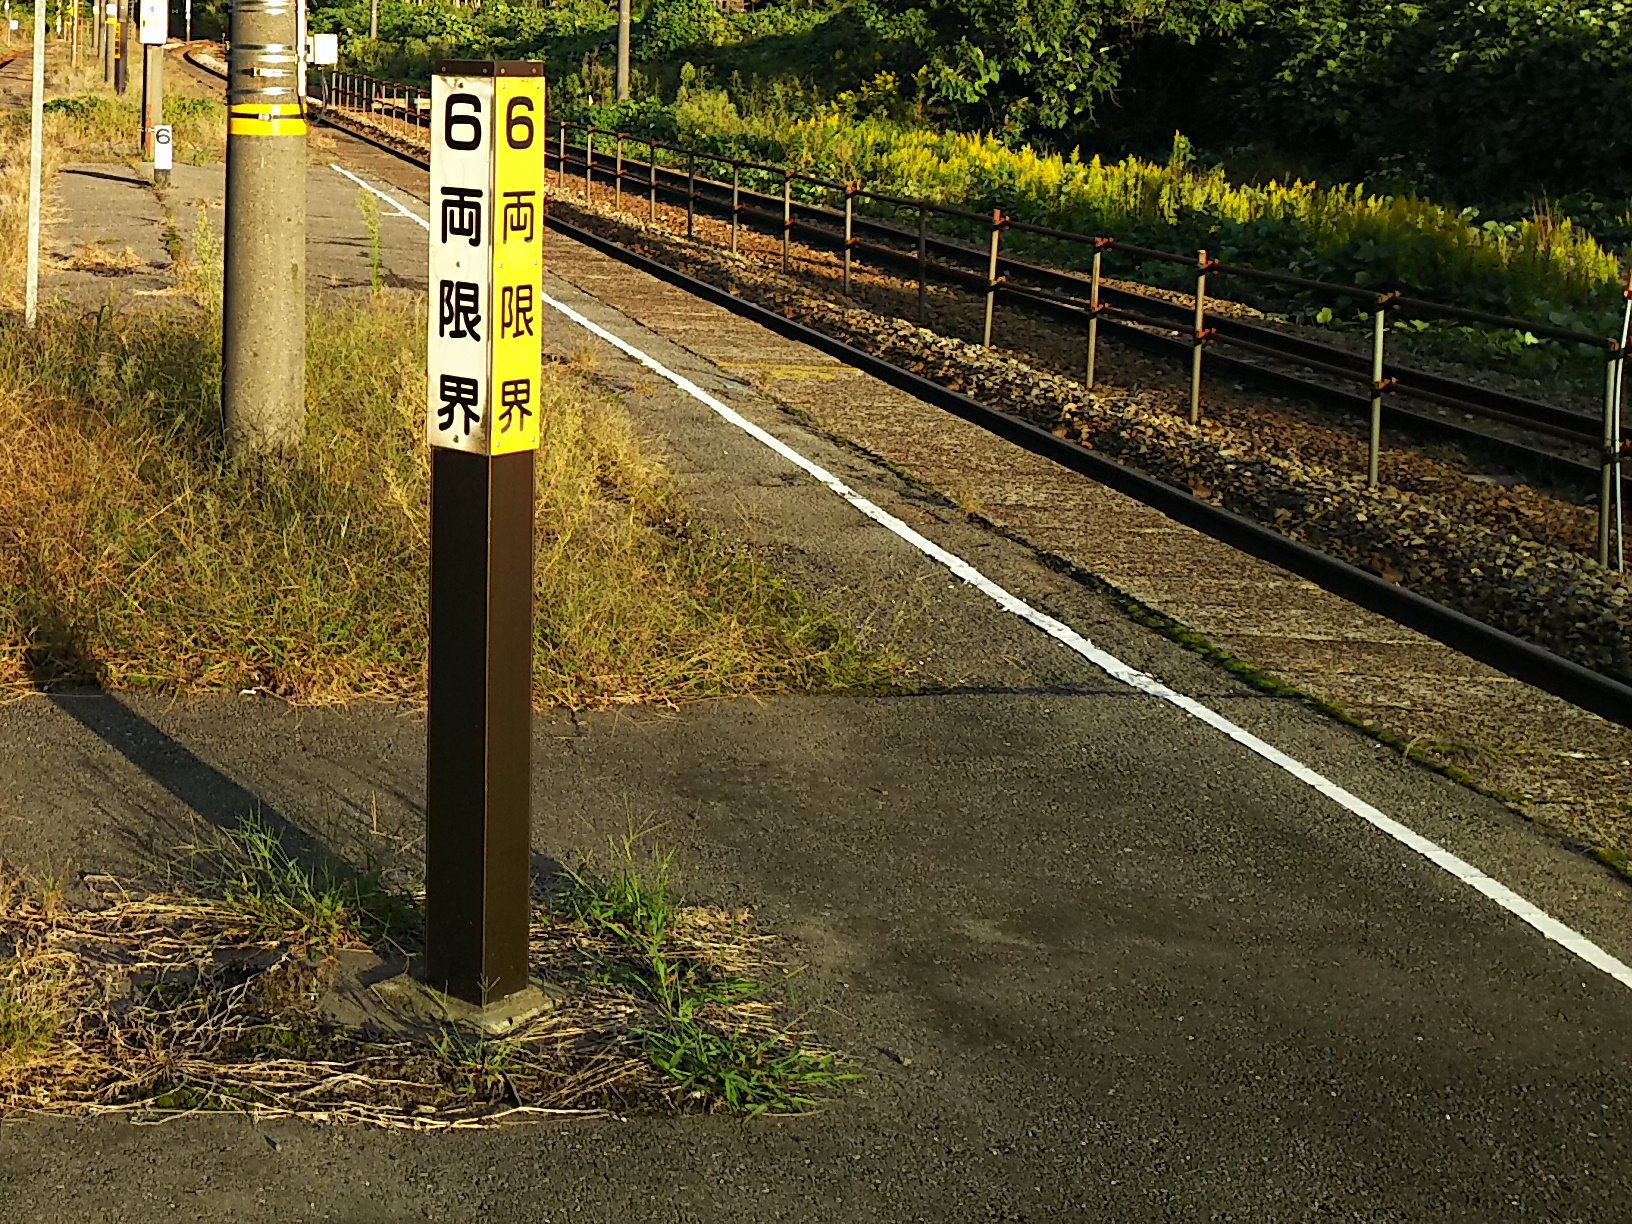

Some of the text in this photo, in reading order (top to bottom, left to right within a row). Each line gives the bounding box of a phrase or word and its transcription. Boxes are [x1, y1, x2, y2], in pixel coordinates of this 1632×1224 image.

[155, 128, 171, 145] 6
[437, 93, 484, 436] 6両限界
[498, 95, 537, 434] 6両限界
